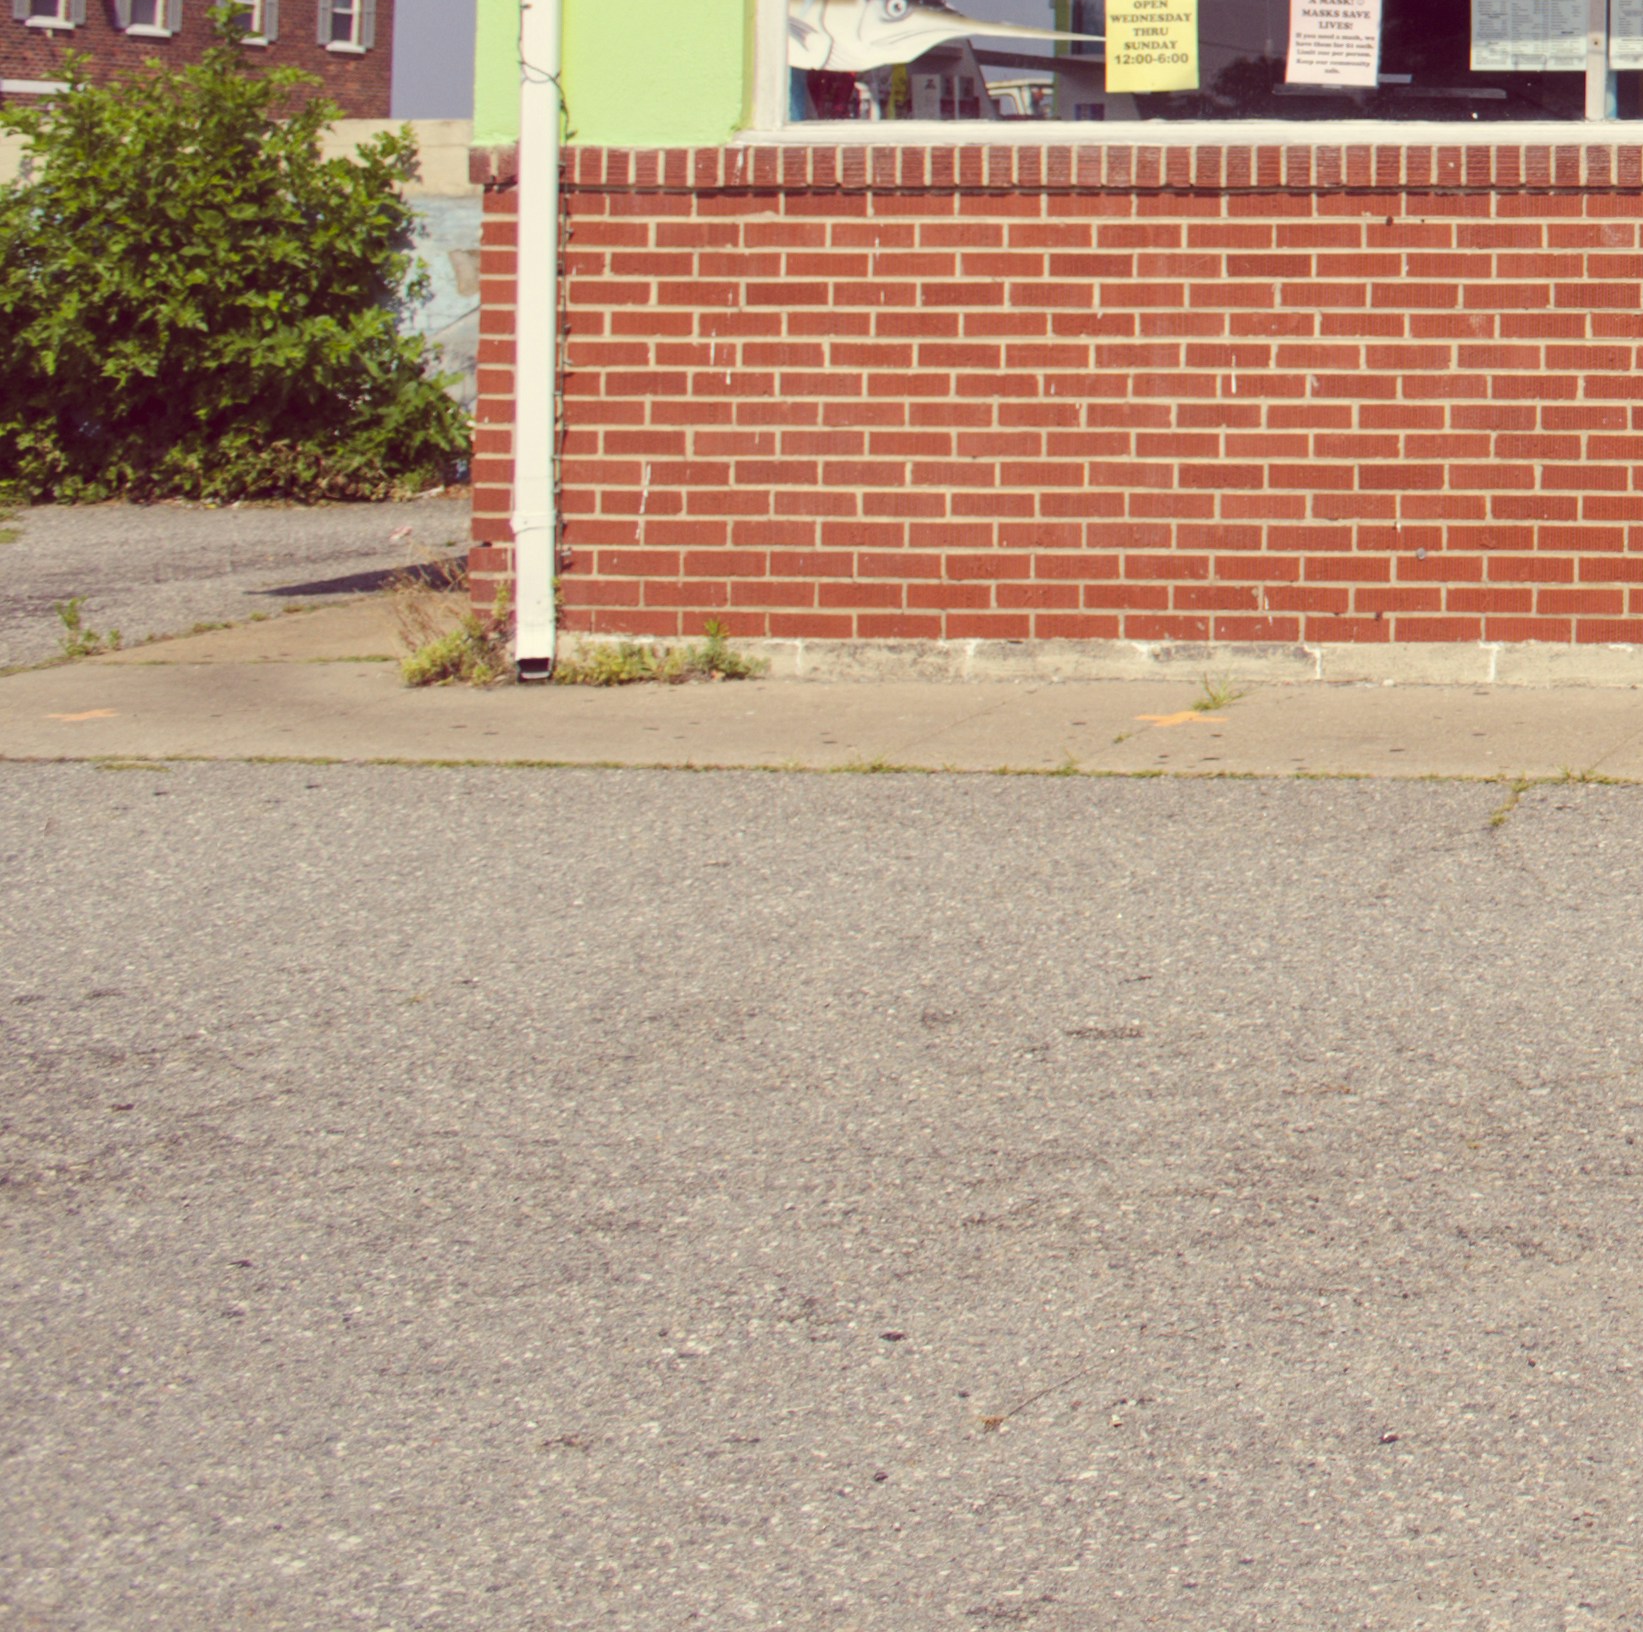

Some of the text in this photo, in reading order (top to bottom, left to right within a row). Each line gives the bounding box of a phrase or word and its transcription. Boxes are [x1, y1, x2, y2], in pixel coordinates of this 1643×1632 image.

[1133, 0, 1168, 9] OPEN
[1110, 13, 1192, 23] WEDNESDAY
[1302, 9, 1371, 19] MASKS SAVE
[1319, 21, 1353, 30] LIVES!
[1133, 28, 1168, 37] THRU
[1124, 40, 1178, 50] SUNDAY
[1115, 53, 1189, 64] 12:00-6:00
